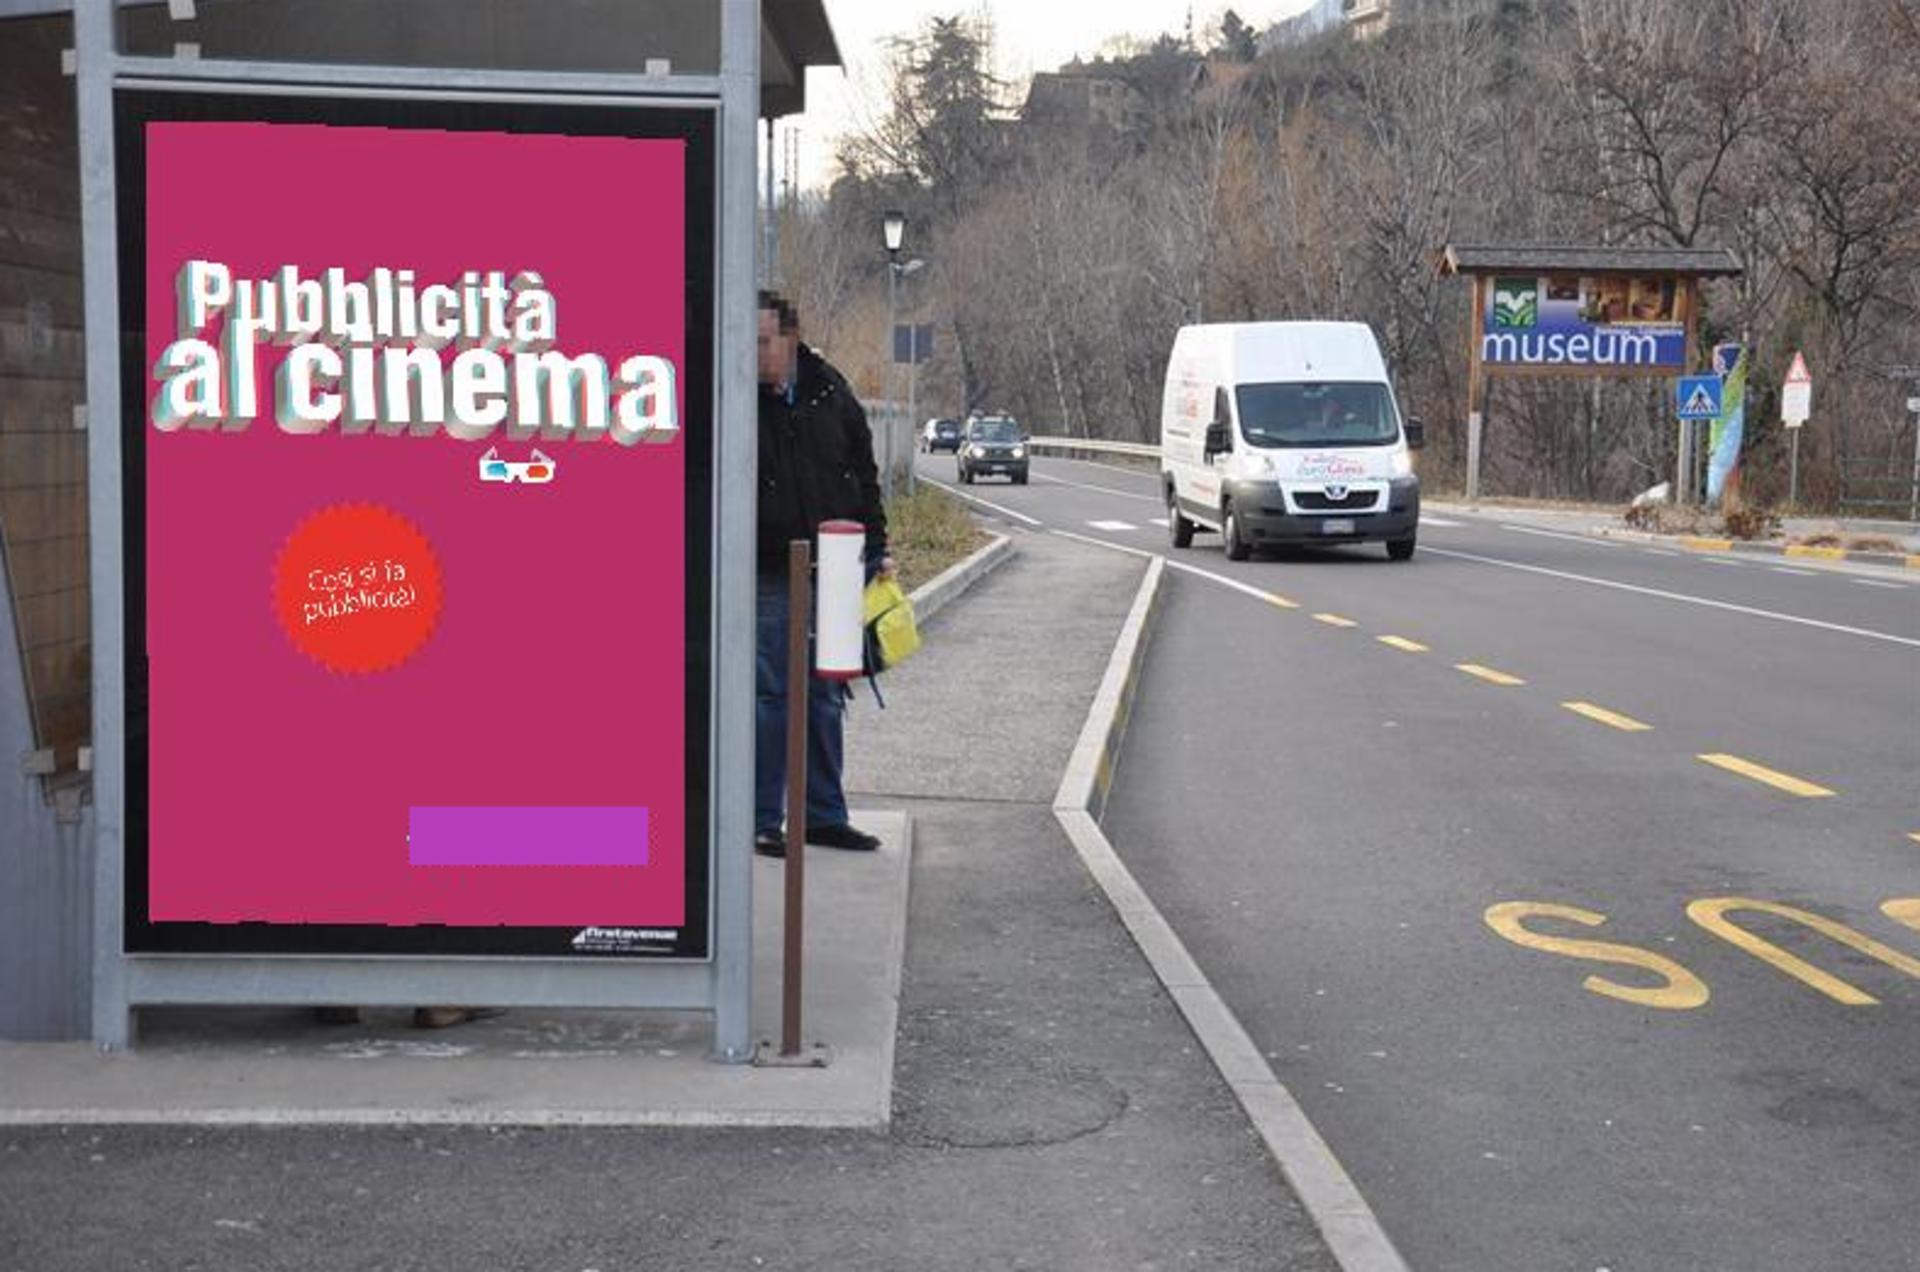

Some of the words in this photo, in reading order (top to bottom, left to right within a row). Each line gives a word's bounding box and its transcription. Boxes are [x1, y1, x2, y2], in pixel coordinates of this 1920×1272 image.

[178, 260, 557, 344] Pubblicità
[1481, 332, 1657, 364] museum
[152, 317, 259, 432] al
[275, 331, 681, 447] cinema
[384, 559, 406, 583] fa
